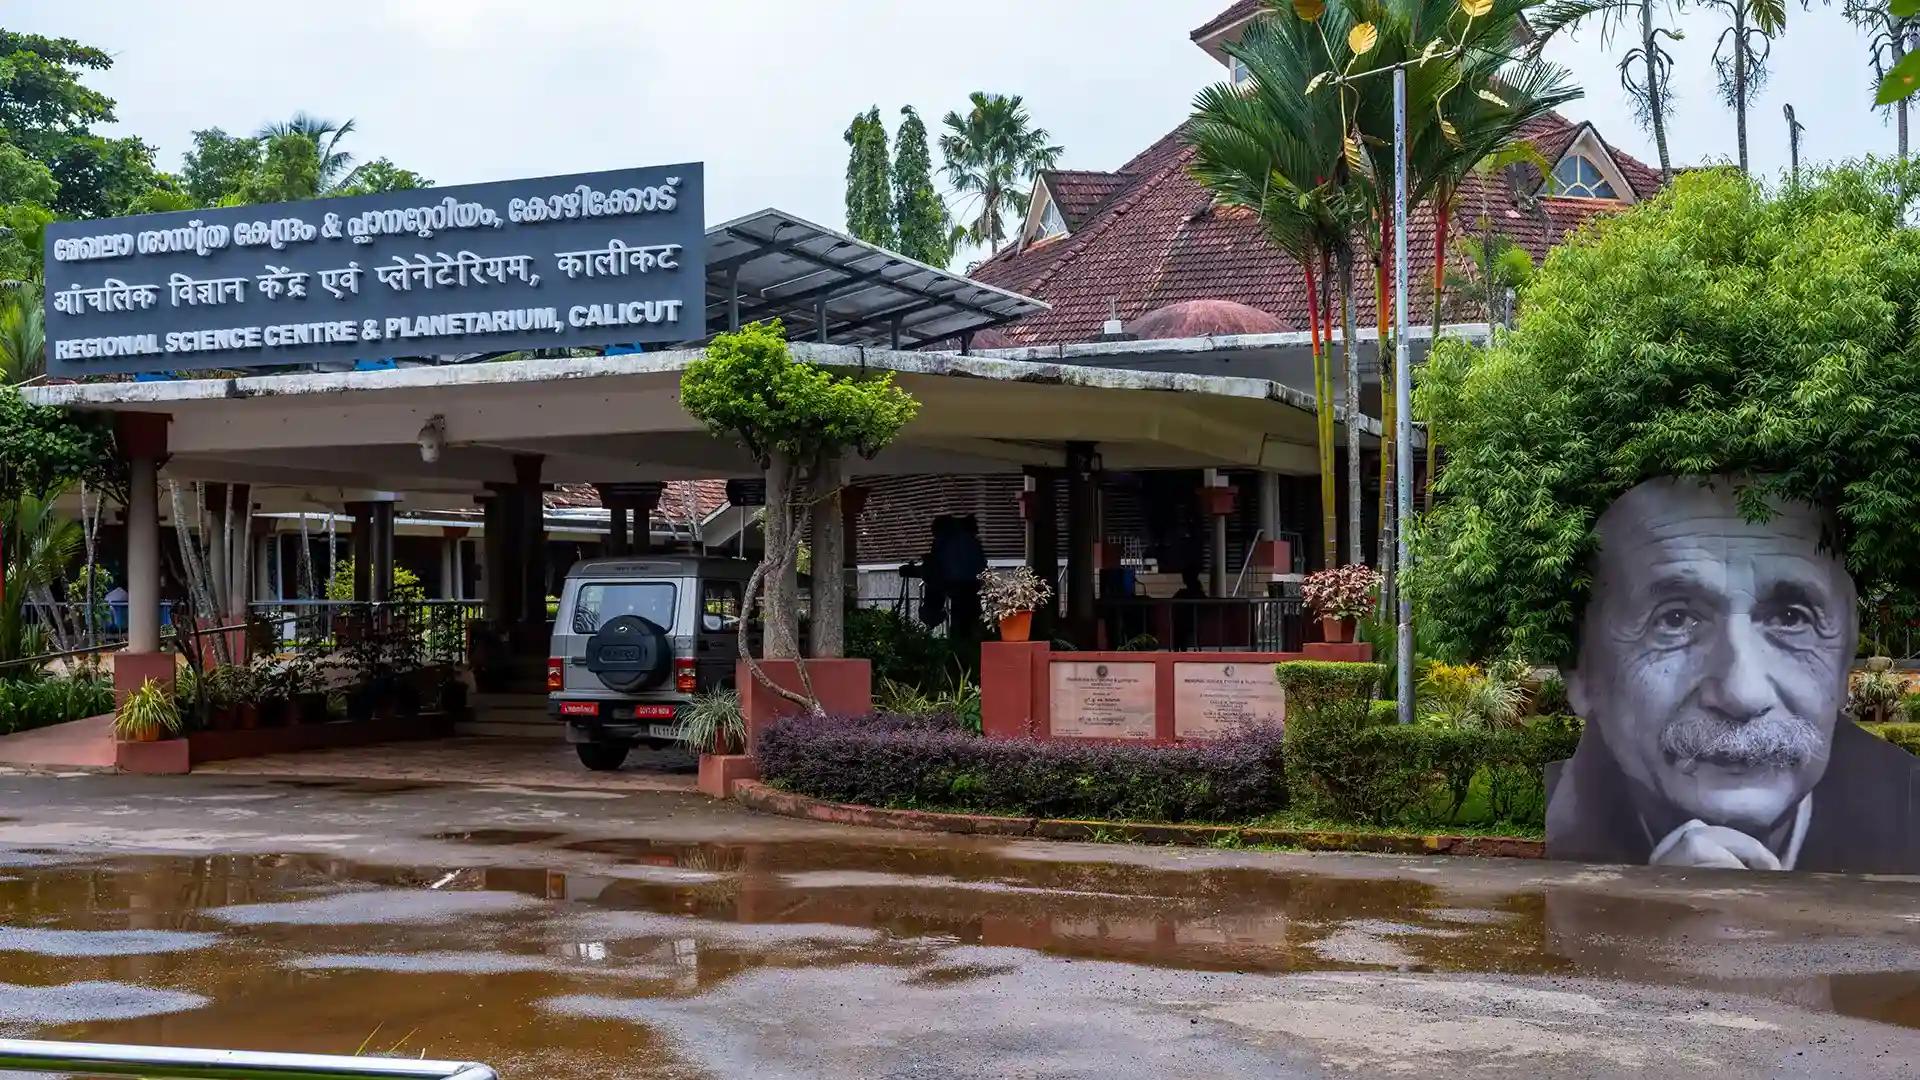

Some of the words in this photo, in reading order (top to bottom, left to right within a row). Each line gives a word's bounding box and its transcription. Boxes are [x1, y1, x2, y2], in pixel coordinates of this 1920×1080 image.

[54, 233, 134, 261] മേഖലാ
[138, 219, 230, 256] ശാസ്ത്ര
[321, 212, 343, 238] &
[509, 176, 682, 222] കോഴിക്കോട്
[54, 278, 160, 315] आंचलिक
[168, 273, 249, 307] विज्ञान
[317, 261, 363, 299] एवं
[374, 250, 541, 288] प्लेनेटेरियम,
[554, 239, 682, 278] कालीकट
[55, 334, 162, 360] REGIONAL
[165, 327, 261, 353] SCIENCE
[265, 321, 358, 346] CENTRE
[362, 319, 381, 341] &
[386, 307, 565, 339] PLANETARIUM,
[569, 300, 682, 327] CALICUT
